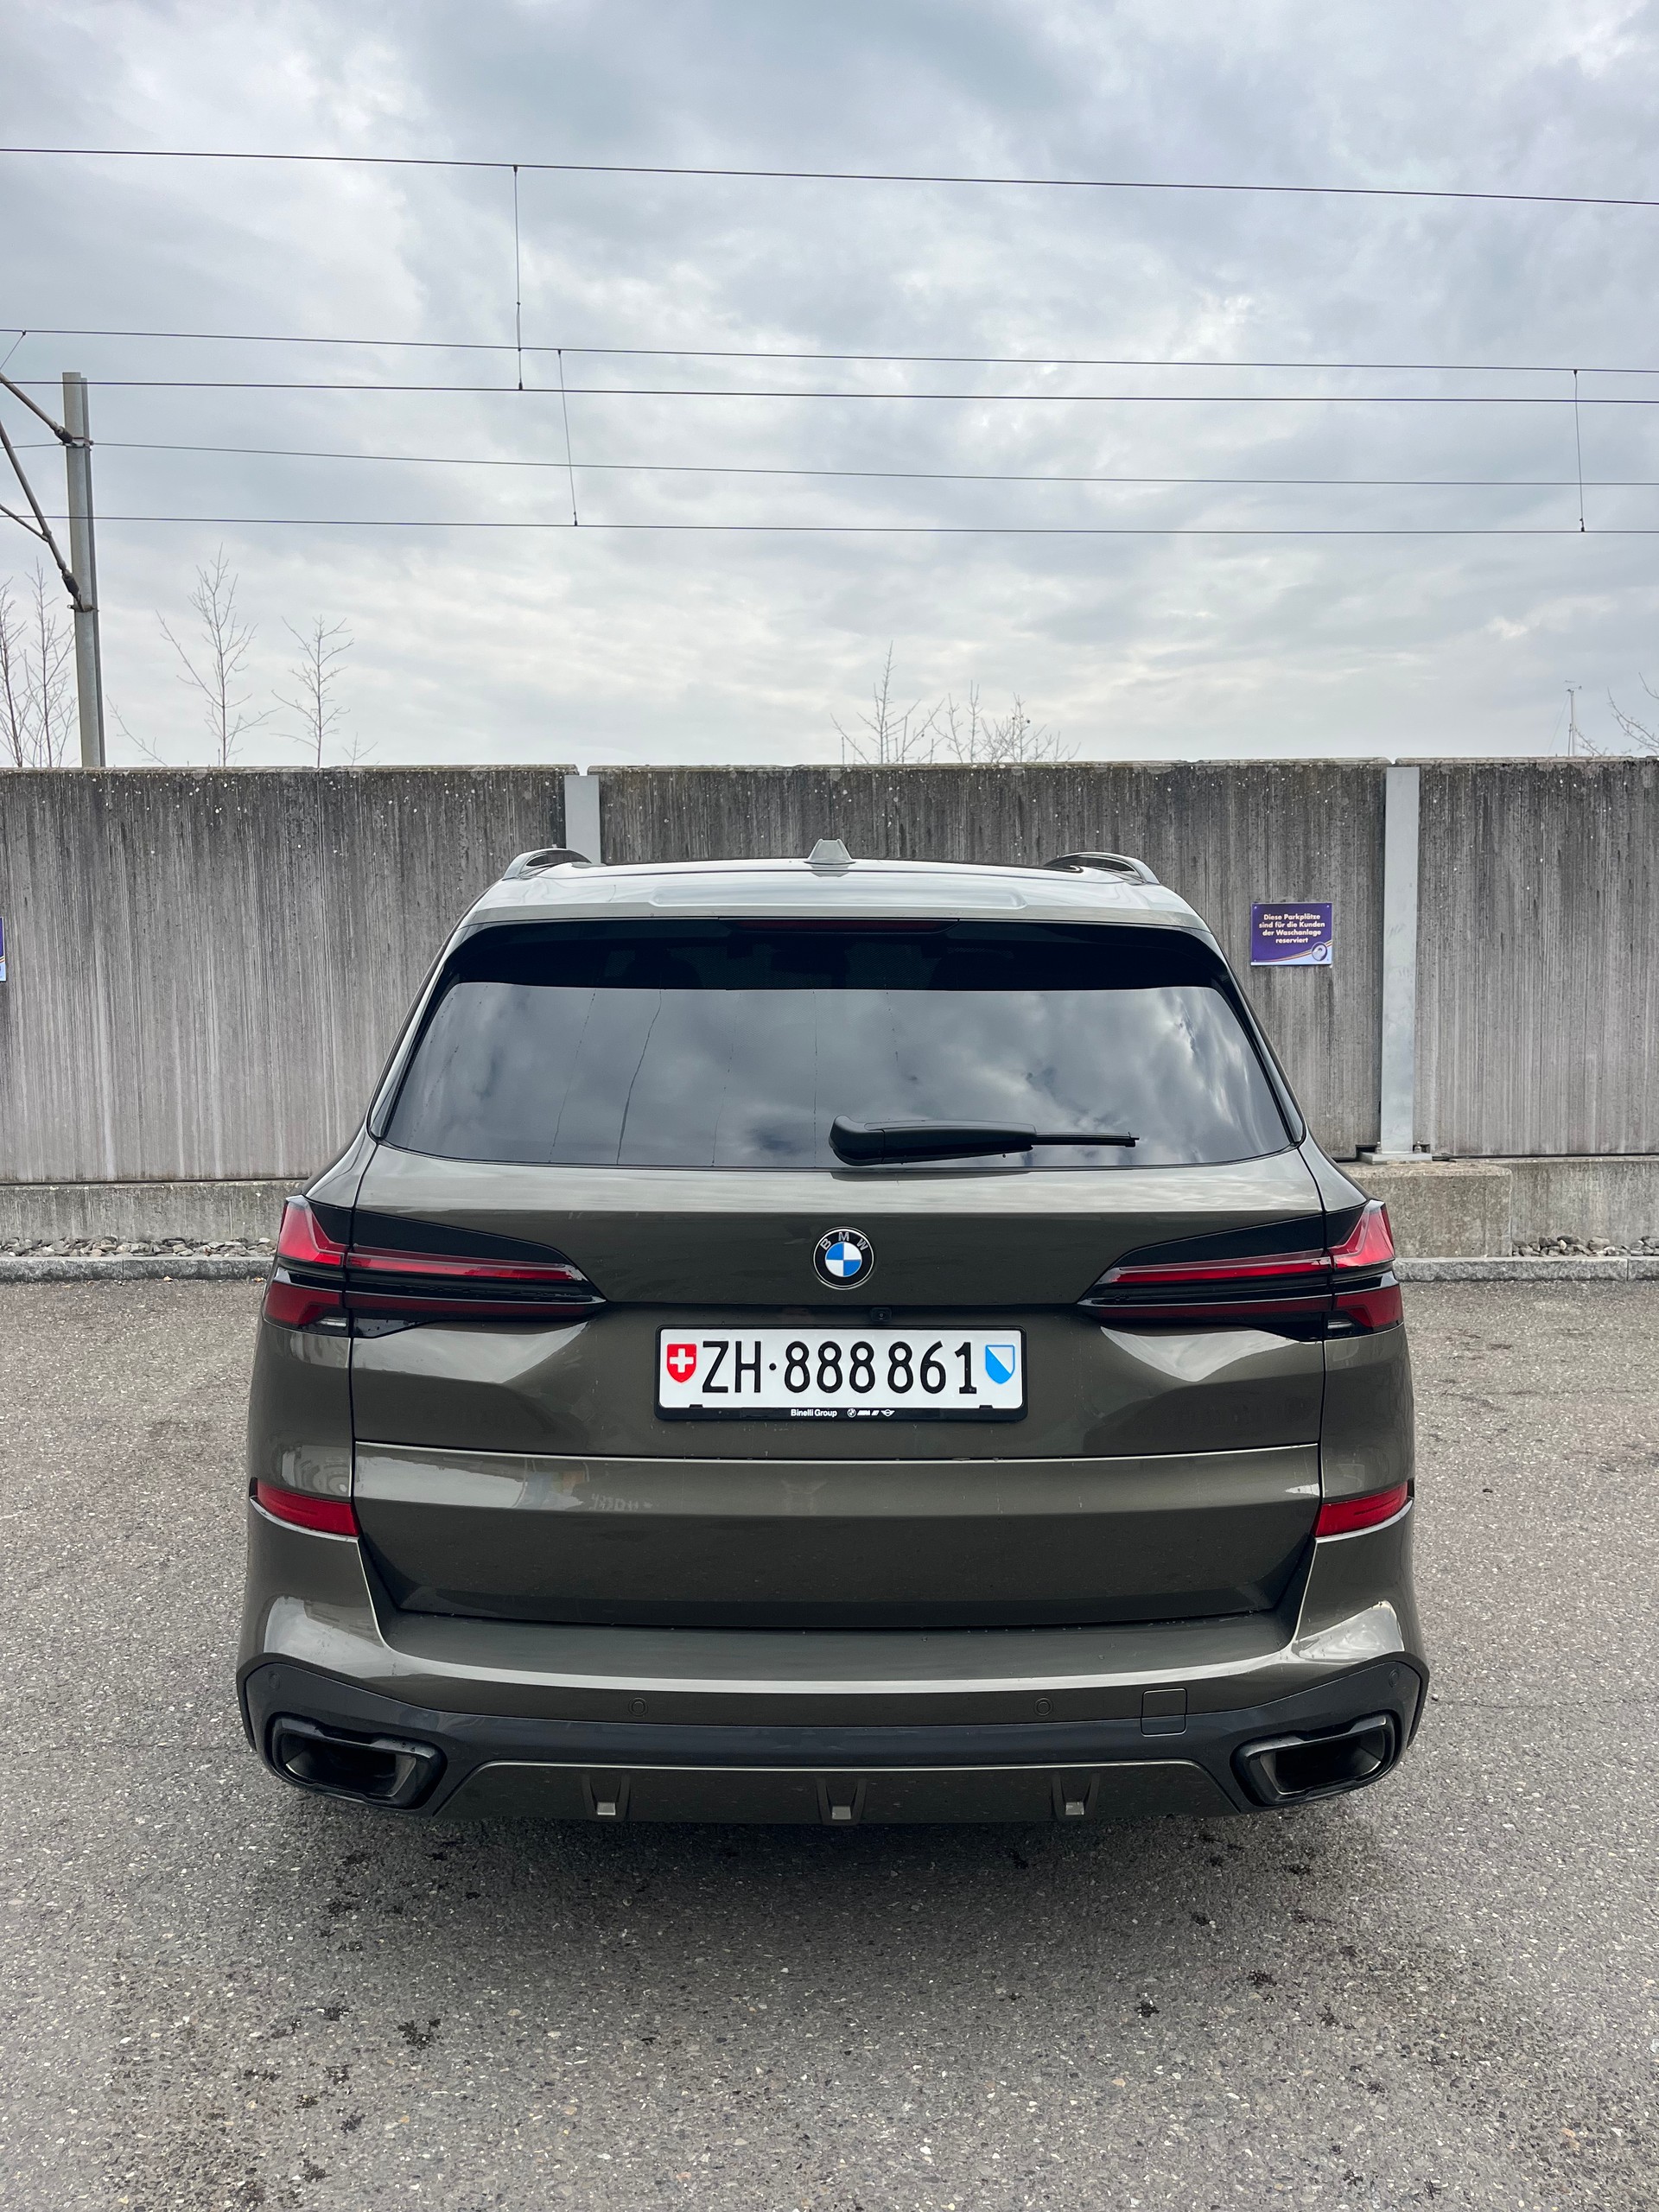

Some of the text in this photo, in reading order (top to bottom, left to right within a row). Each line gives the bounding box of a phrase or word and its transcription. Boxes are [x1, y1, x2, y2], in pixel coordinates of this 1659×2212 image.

[820, 1231, 869, 1251] BMW
[791, 1408, 838, 1418] Binelli Group
